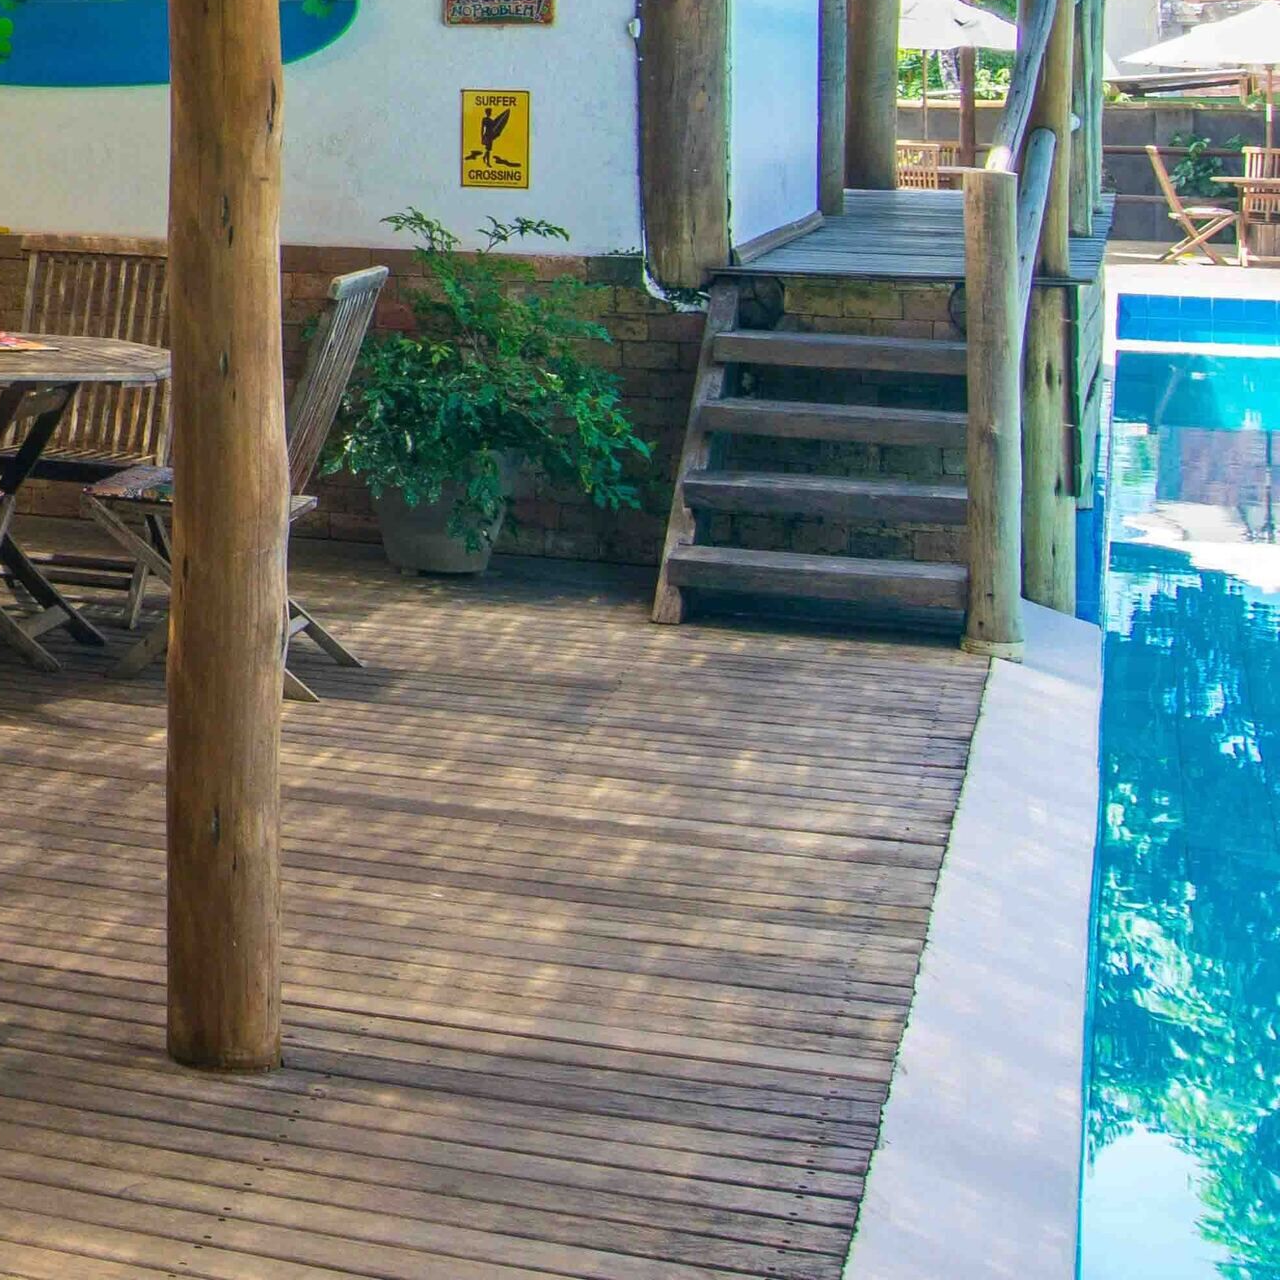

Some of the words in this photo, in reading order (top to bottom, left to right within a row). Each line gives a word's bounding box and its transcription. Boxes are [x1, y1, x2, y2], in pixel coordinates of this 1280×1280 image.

[452, 5, 471, 17] NO
[475, 96, 517, 106] SURFER
[468, 170, 522, 181] CROSSING
